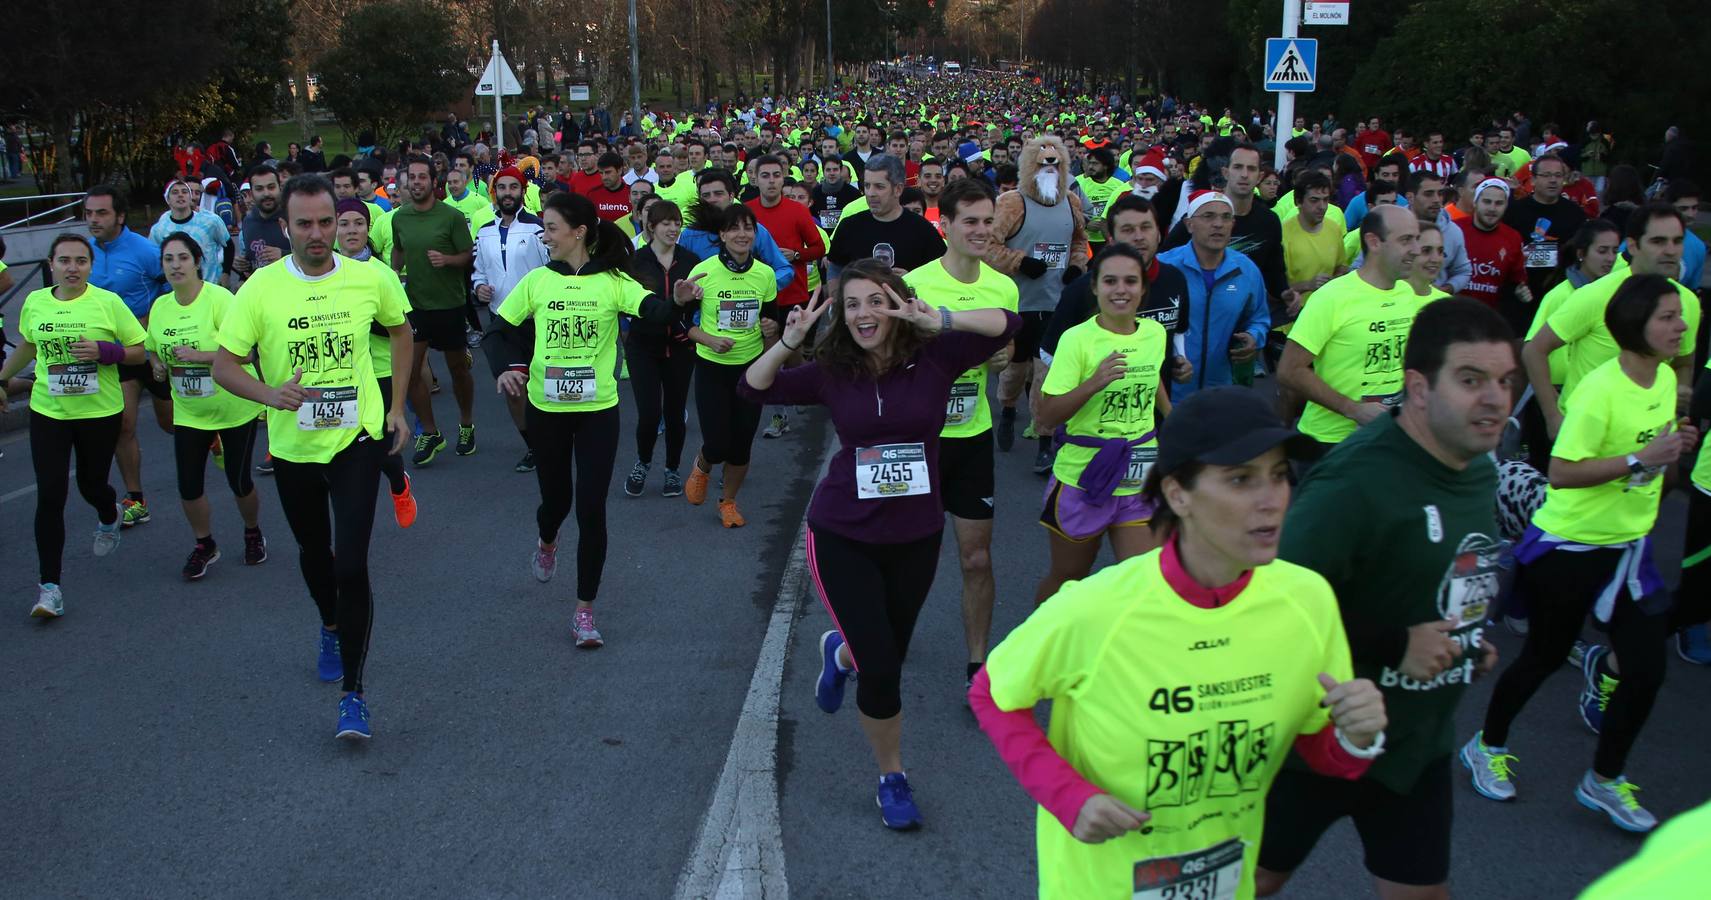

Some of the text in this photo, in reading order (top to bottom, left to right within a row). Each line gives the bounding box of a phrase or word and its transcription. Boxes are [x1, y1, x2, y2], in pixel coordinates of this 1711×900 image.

[717, 290, 732, 299] 46
[547, 300, 565, 311] 46
[288, 316, 310, 331] 46
[311, 311, 351, 323] SANSILVESTRE
[730, 310, 749, 321] 950
[38, 322, 54, 333] 46
[163, 328, 177, 337] 46
[1369, 321, 1386, 333] 46
[58, 374, 89, 387] 4442
[556, 380, 583, 394] 1423
[322, 391, 336, 399] 46
[312, 402, 344, 419] 1434
[882, 449, 897, 459] 46
[870, 462, 913, 484] 2455
[1148, 685, 1195, 714] 46
[1196, 672, 1273, 699] SANSILVESTRE
[1182, 857, 1206, 874] 46
